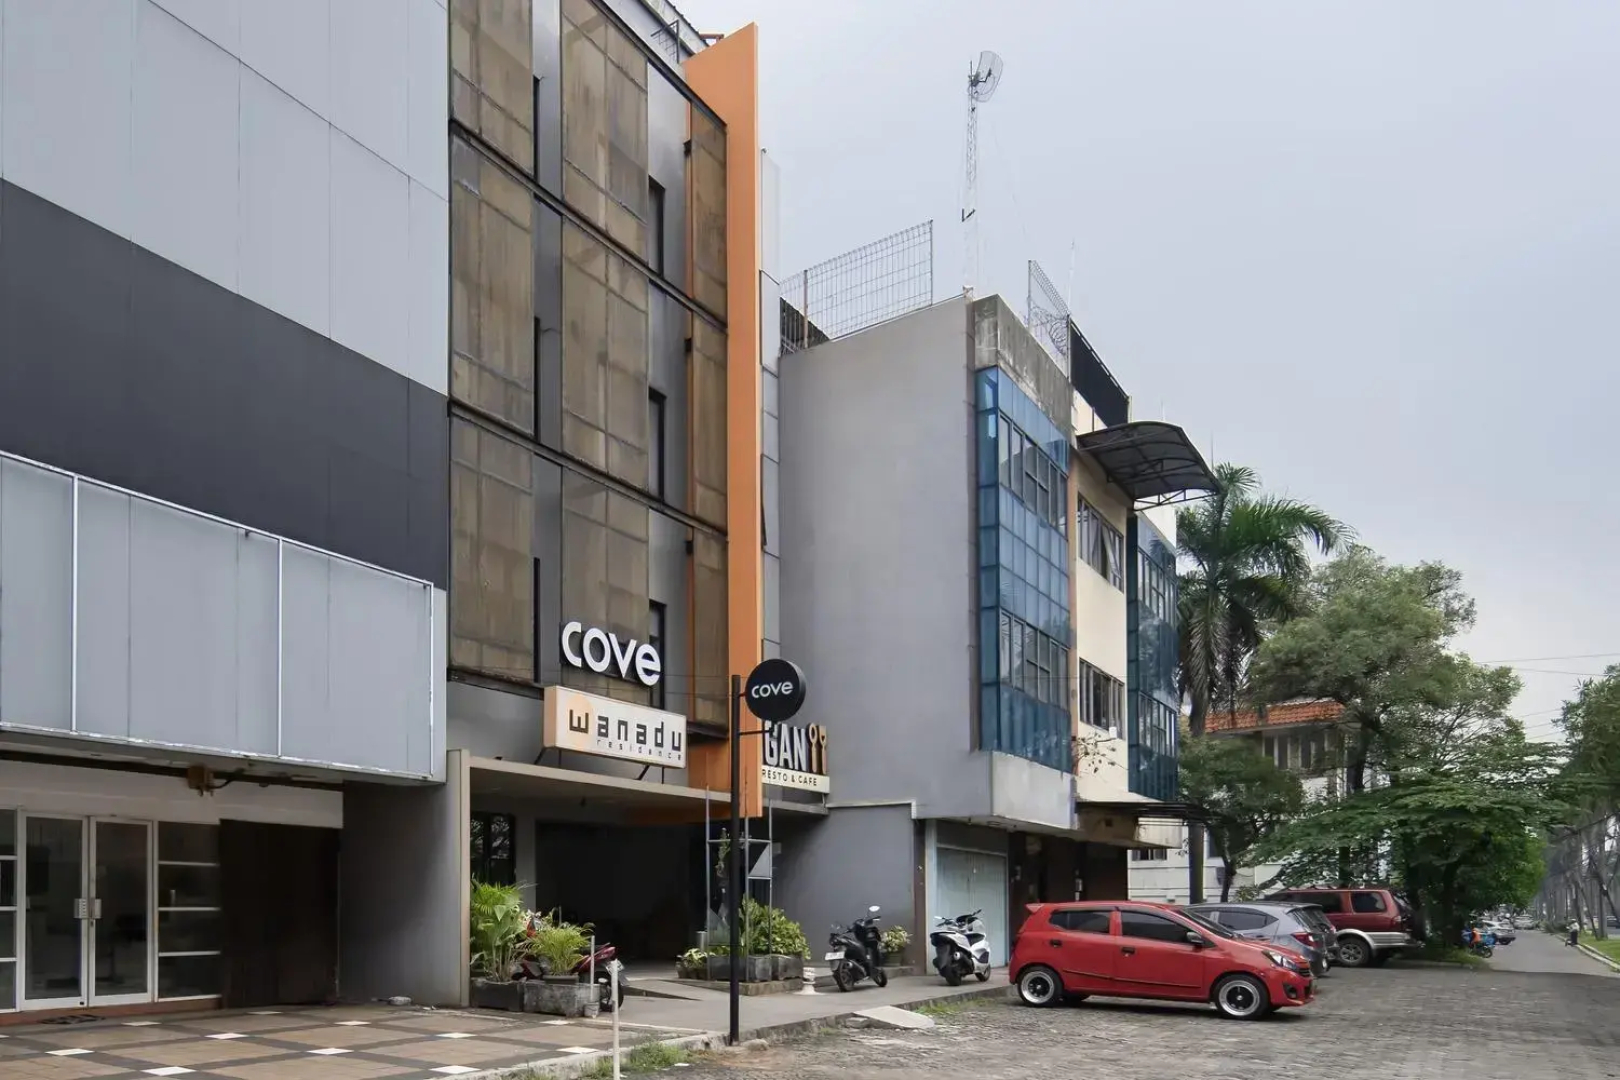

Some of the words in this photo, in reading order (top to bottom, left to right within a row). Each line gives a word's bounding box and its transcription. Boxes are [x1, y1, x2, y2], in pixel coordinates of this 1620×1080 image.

[562, 621, 660, 686] cove
[751, 681, 793, 698] cove
[569, 709, 682, 752] wanadu
[762, 769, 787, 782] RESTO
